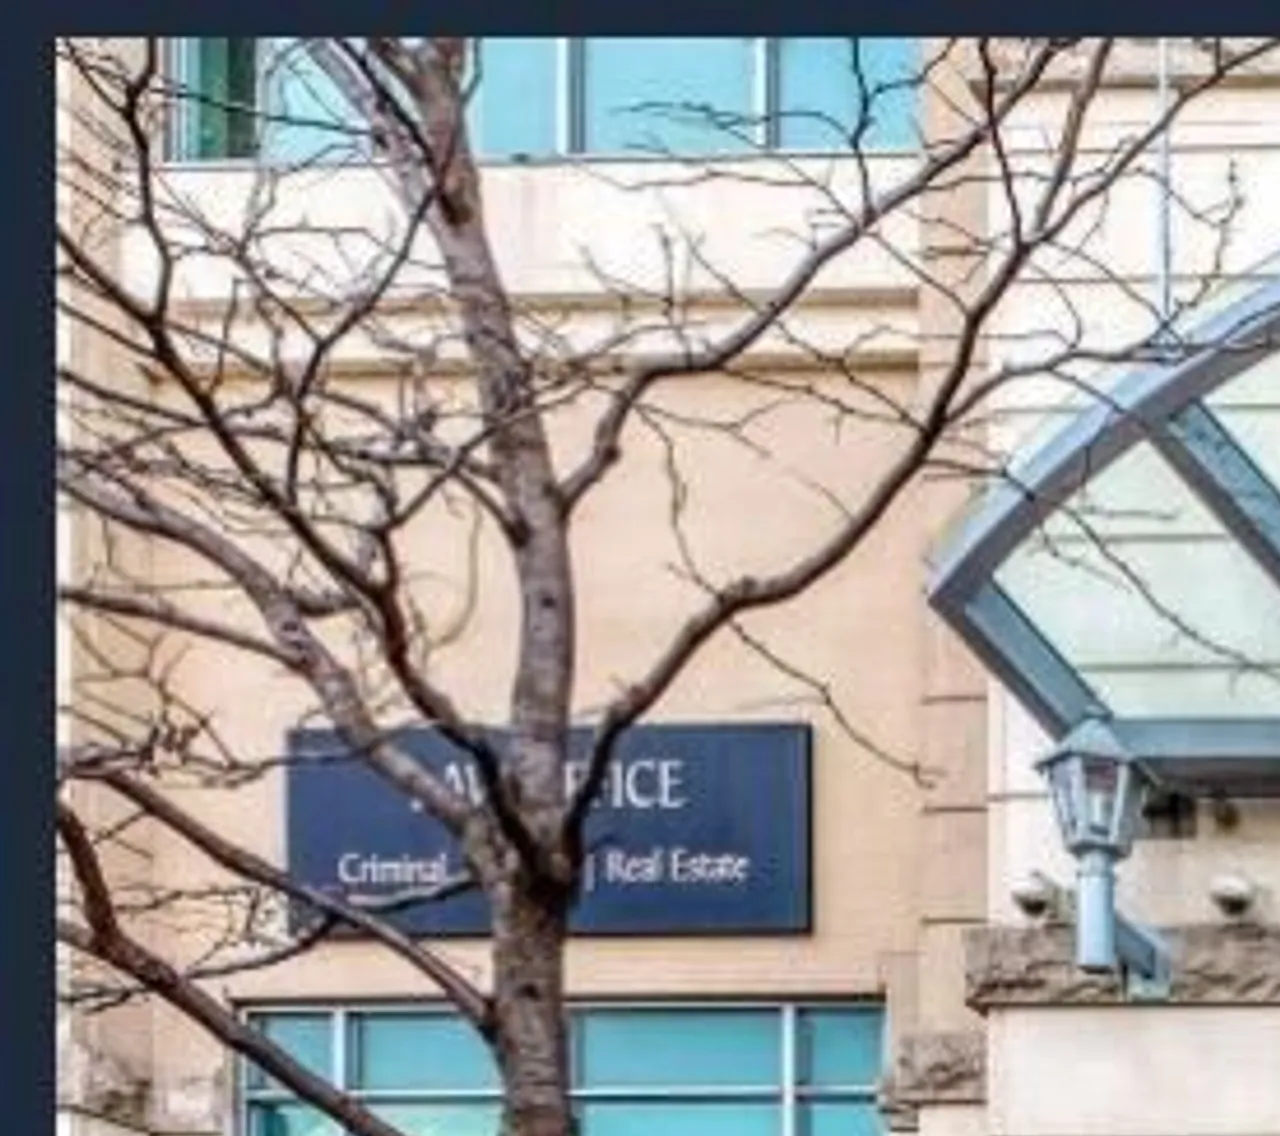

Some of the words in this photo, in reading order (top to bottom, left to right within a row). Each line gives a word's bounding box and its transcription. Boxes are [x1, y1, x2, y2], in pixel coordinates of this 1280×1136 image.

[337, 852, 447, 884] Criminal
[606, 846, 664, 884] Real
[671, 846, 749, 884] Estate
